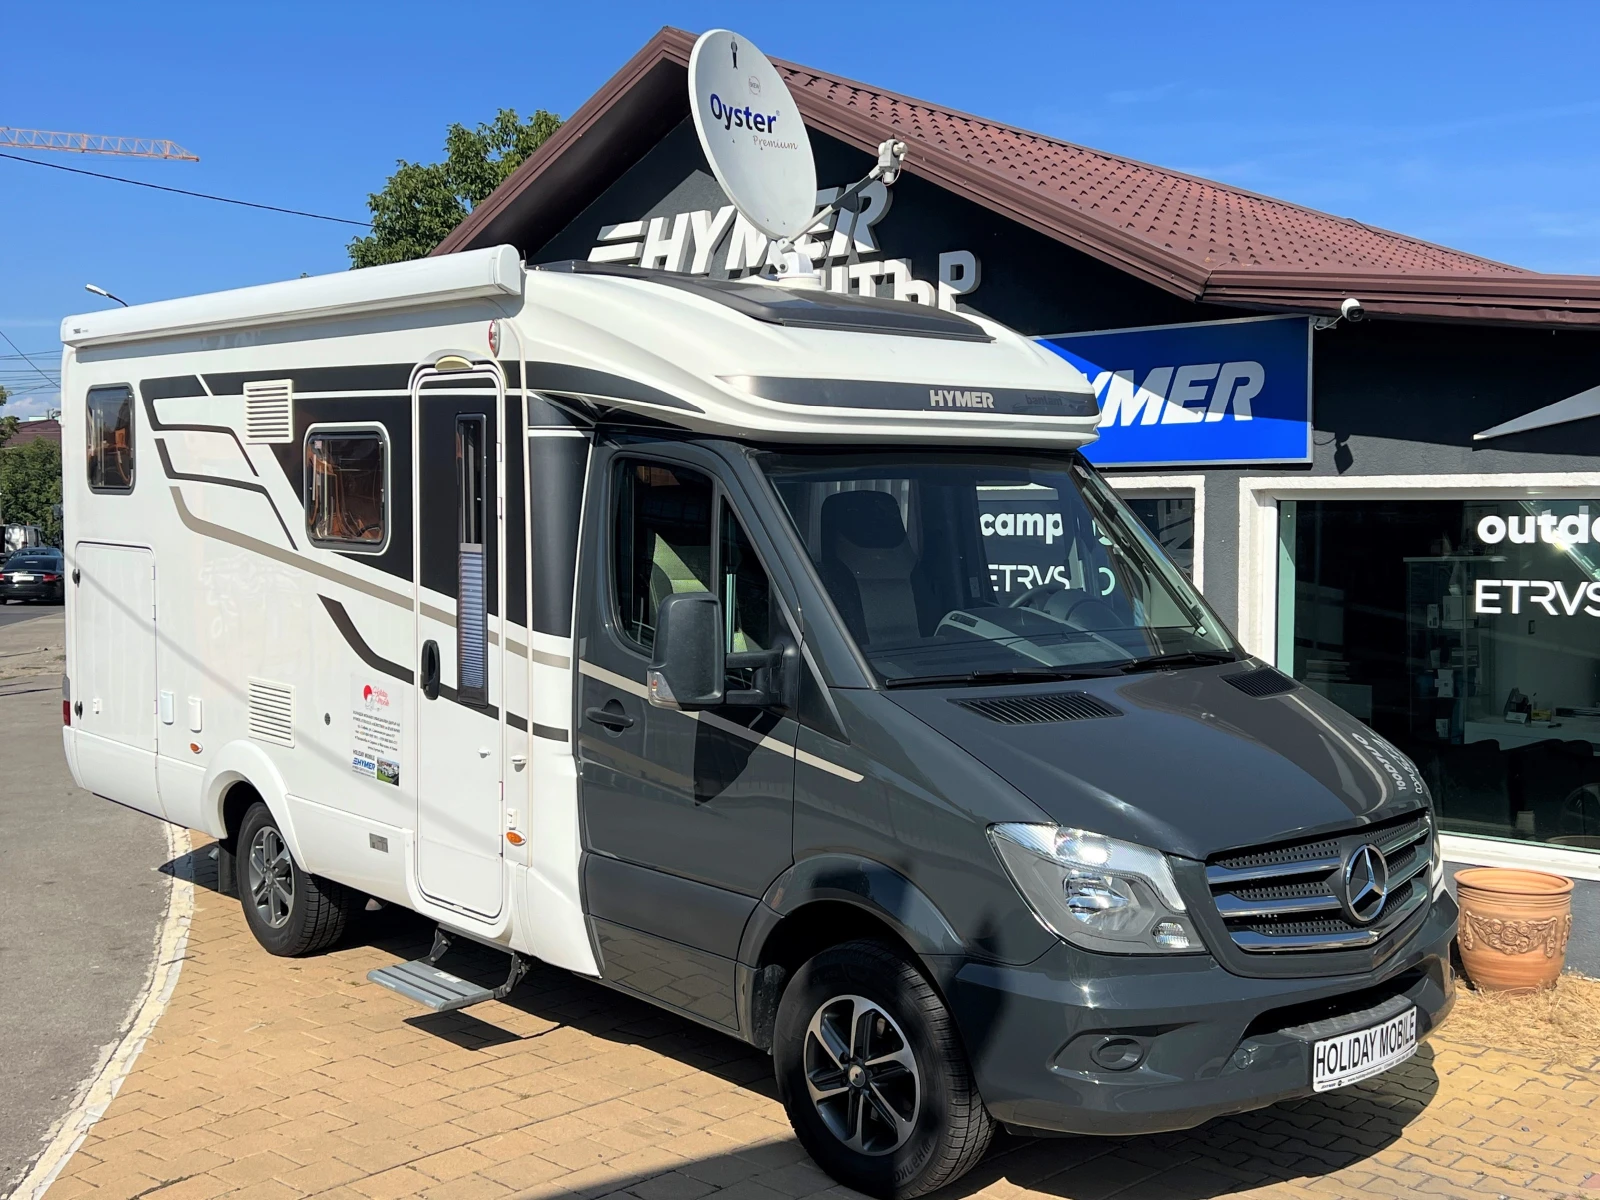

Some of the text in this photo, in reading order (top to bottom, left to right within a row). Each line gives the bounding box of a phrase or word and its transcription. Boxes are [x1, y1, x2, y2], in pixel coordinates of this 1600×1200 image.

[710, 93, 777, 134] Oyster
[753, 135, 798, 149] Premium
[640, 180, 893, 275] HYMER
[929, 389, 995, 409] HYMER
[1083, 361, 1266, 428] MER
[979, 512, 1113, 546] camp
[1316, 1029, 1377, 1078] HOLIDAY
[1379, 1010, 1415, 1058] MOBILE
